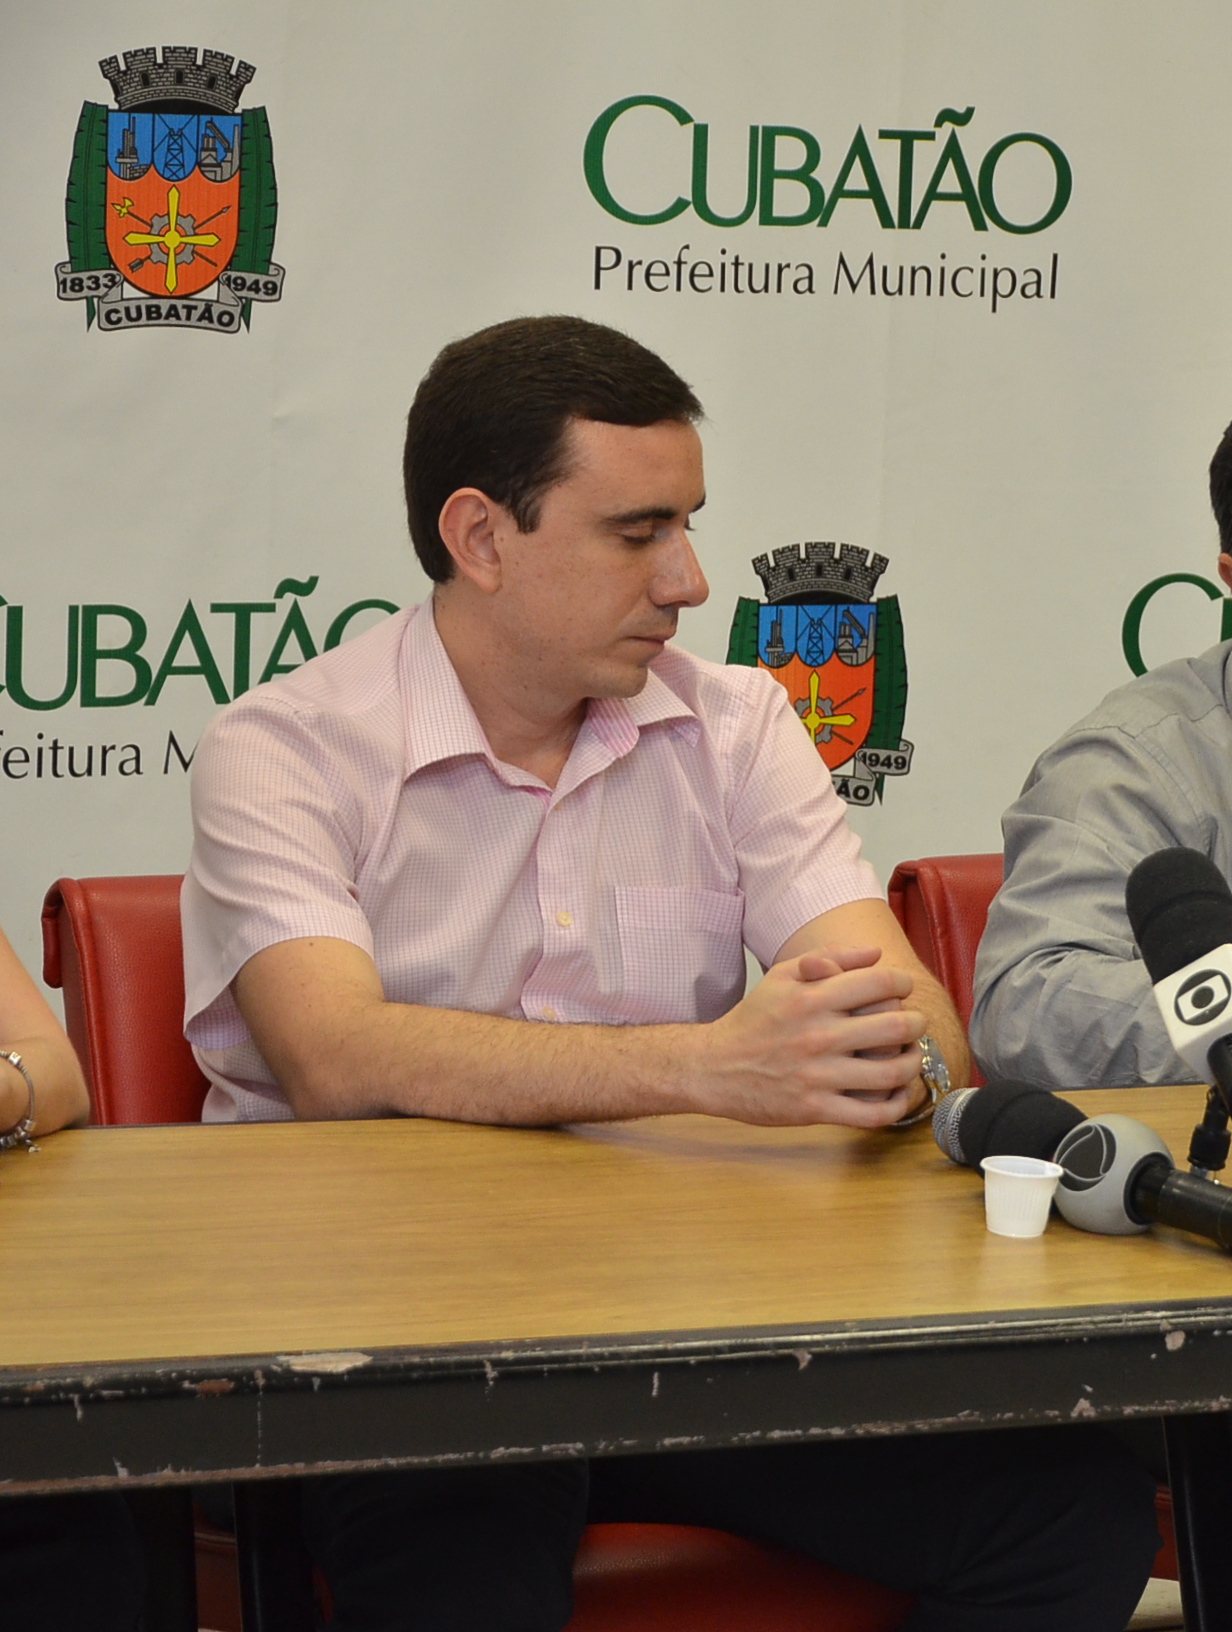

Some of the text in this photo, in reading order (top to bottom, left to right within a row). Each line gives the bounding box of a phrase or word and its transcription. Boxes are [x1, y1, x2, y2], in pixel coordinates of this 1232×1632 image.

[583, 94, 1073, 235] CUBATÃO
[60, 273, 117, 294] 1833
[225, 274, 278, 296] 1949
[593, 243, 1059, 313] Prefeitura Municipal
[104, 302, 235, 327] CUBATÃO
[0, 575, 401, 711] UBATÃ
[0, 729, 144, 779] eitura
